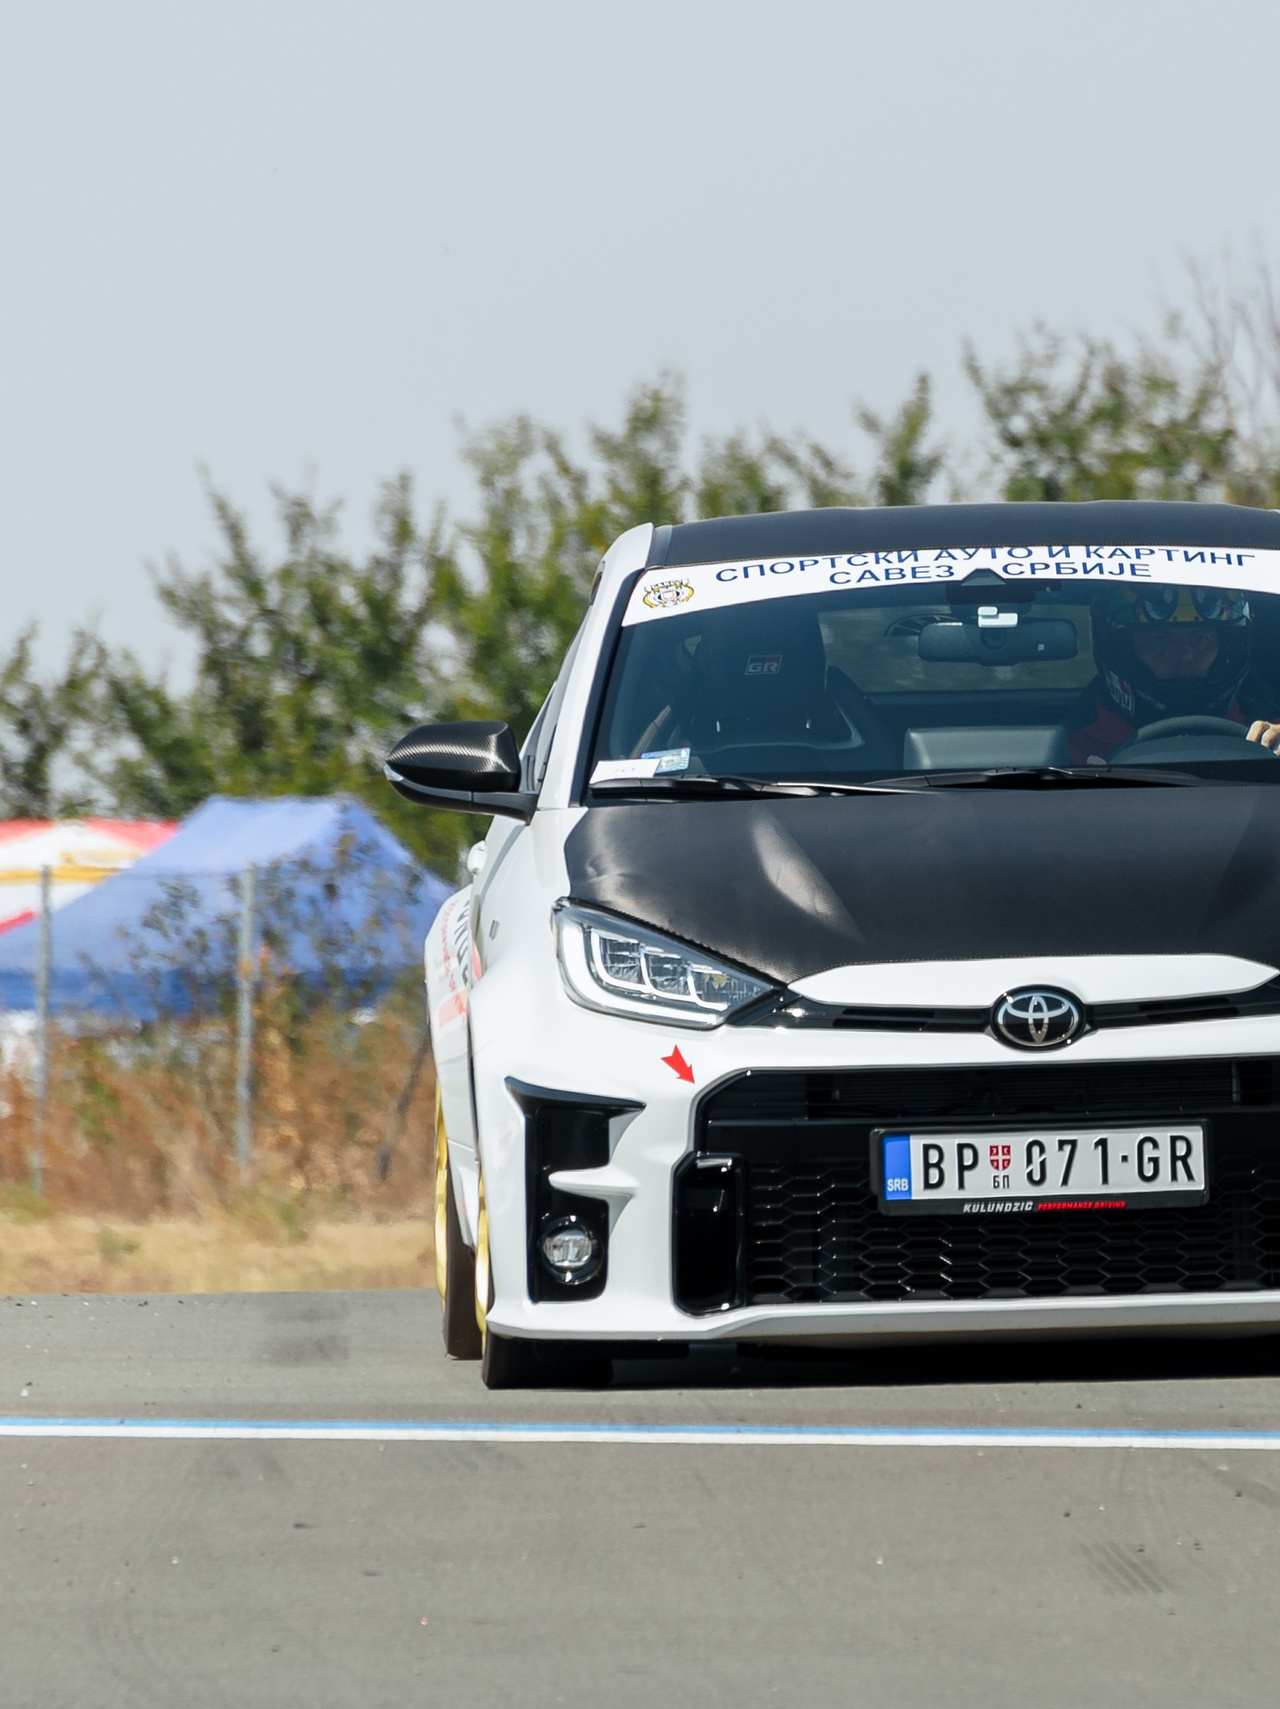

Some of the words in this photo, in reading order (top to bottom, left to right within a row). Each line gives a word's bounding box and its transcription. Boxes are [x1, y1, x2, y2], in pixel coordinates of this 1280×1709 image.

[715, 550, 919, 582] СПОРТСКИ
[933, 547, 1033, 561] АУТО
[1047, 545, 1071, 558] И
[1085, 545, 1255, 567] КАРТИНГ
[829, 565, 954, 585] САВЕЗ
[1002, 562, 1152, 578] СРБИЈЕ
[748, 662, 778, 673] GR
[922, 1142, 979, 1191] BP
[887, 1178, 909, 1192] SRB
[993, 1175, 1010, 1189] БП
